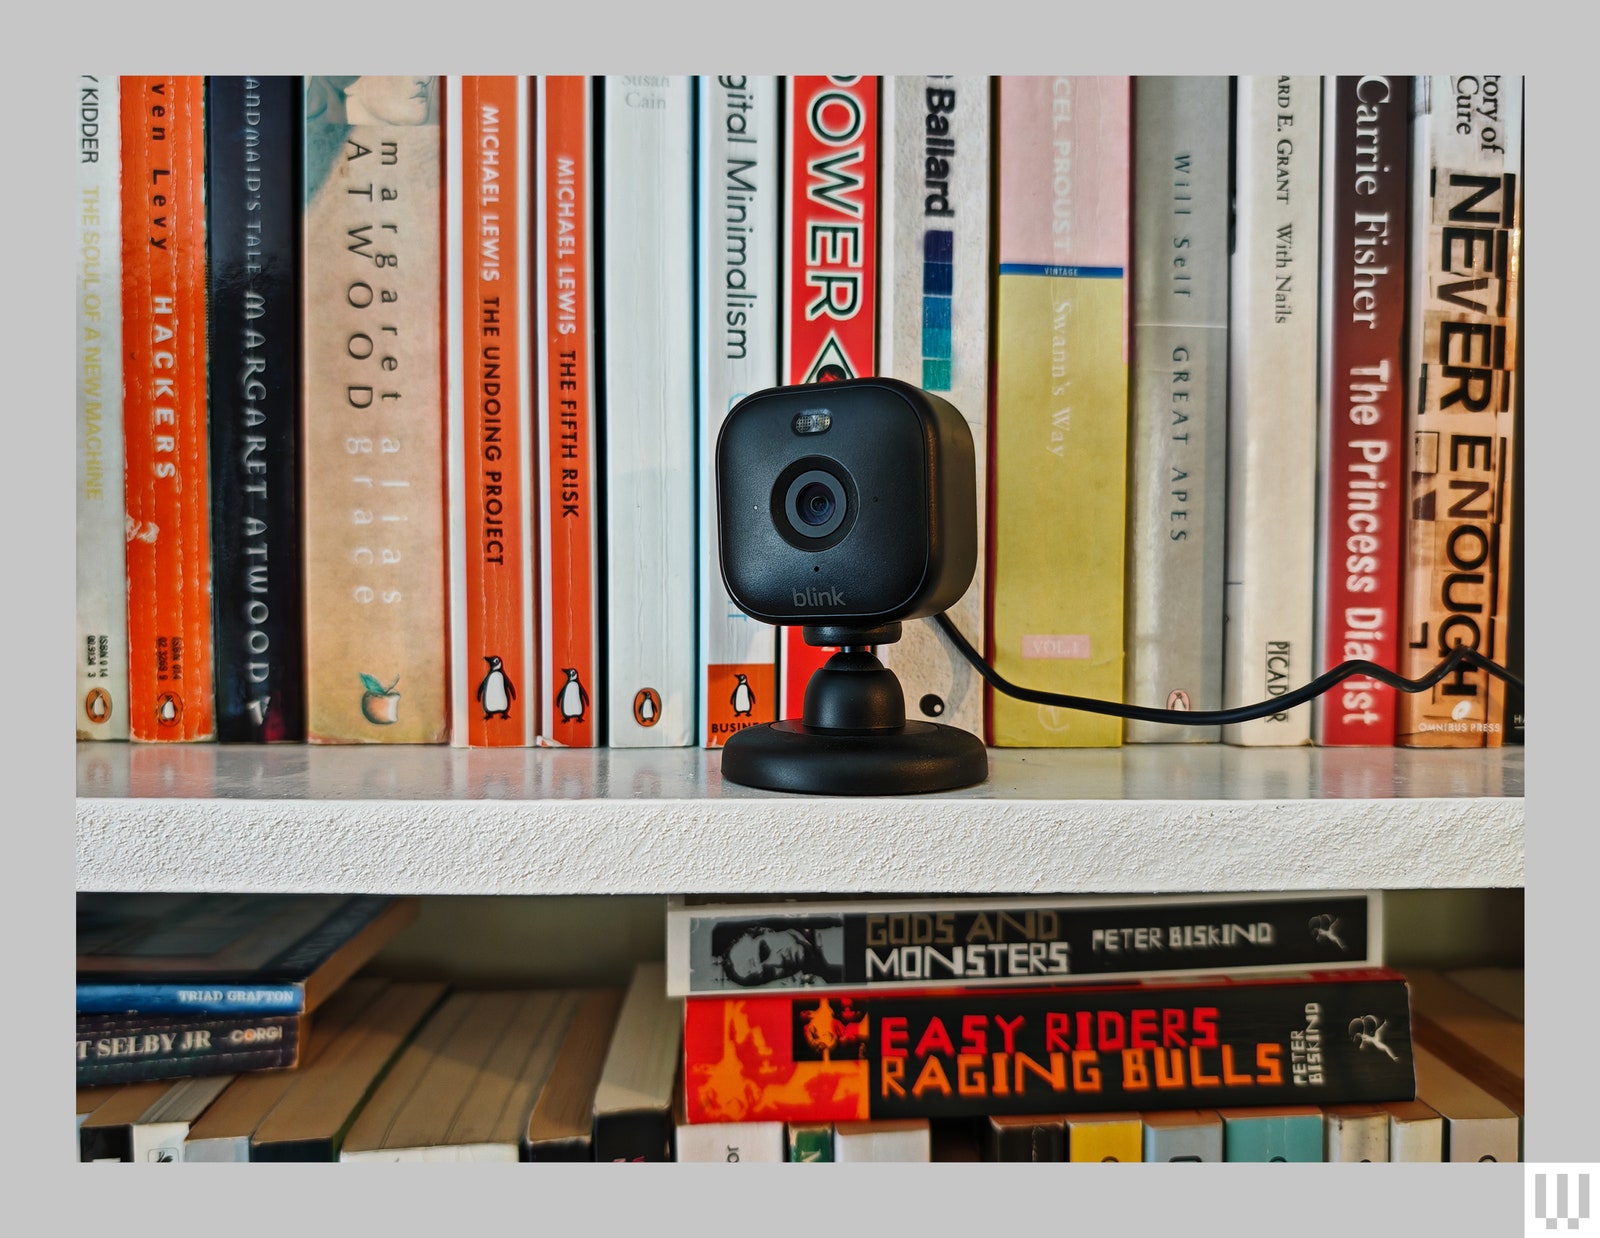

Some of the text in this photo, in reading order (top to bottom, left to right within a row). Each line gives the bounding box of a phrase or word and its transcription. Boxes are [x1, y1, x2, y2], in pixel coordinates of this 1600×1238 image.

[81, 88, 100, 164] KIDDER
[625, 92, 667, 111] Cain
[1276, 114, 1294, 132] E.
[1456, 76, 1480, 136] Cure
[1481, 127, 1504, 155] of
[150, 83, 170, 250] ven Levy
[481, 105, 501, 282] MICHAEL LEWIS
[924, 86, 956, 219] Ballard
[1052, 140, 1072, 254] PROUST
[1275, 139, 1294, 205] GRANT
[245, 219, 263, 273] TALE
[556, 156, 577, 335] MICHAEL LEWIS
[1172, 154, 1192, 298] Will Self
[1352, 76, 1391, 330] Carrie Fisher
[347, 140, 374, 409] ATWOOD
[375, 141, 402, 401] margaret
[726, 159, 758, 360] Minimalism
[1044, 267, 1079, 277] VINTAGE
[1274, 223, 1293, 325] With Nails
[82, 186, 105, 501] THE SOUL OF A NEW MACHINE
[153, 296, 176, 479] HACKERS
[1046, 300, 1071, 458] Swann's Way
[483, 296, 504, 566] THE UNDOING PROJECT
[559, 350, 580, 519] THE FIFTH RISK
[1170, 347, 1191, 542] GREAT APES
[1436, 173, 1502, 697] NEVER ENOUGH
[242, 291, 270, 684] MARGARET ATWOOD
[345, 437, 374, 604] grace
[380, 437, 411, 604] alias
[1342, 359, 1391, 725] The Princess Diaist
[792, 586, 847, 607] blink
[100, 635, 109, 658] ISBN
[1266, 640, 1290, 723] PICADR
[1418, 722, 1501, 733] OMNIBUS PRESS
[865, 941, 1070, 980] MONSTERS
[866, 909, 1061, 947] GODS AND
[1092, 922, 1276, 951] PETER BISKIND
[178, 989, 295, 1002] TRIAD GRAFTON
[229, 1026, 283, 1045] CORGI
[880, 1006, 1221, 1060] EASY RIDERS
[96, 1032, 177, 1059] SELBY
[181, 1029, 212, 1051] JR
[880, 1042, 1284, 1099] RAGING BULLS
[1290, 1030, 1308, 1087] PETER
[1305, 1002, 1326, 1086] BISKIND
